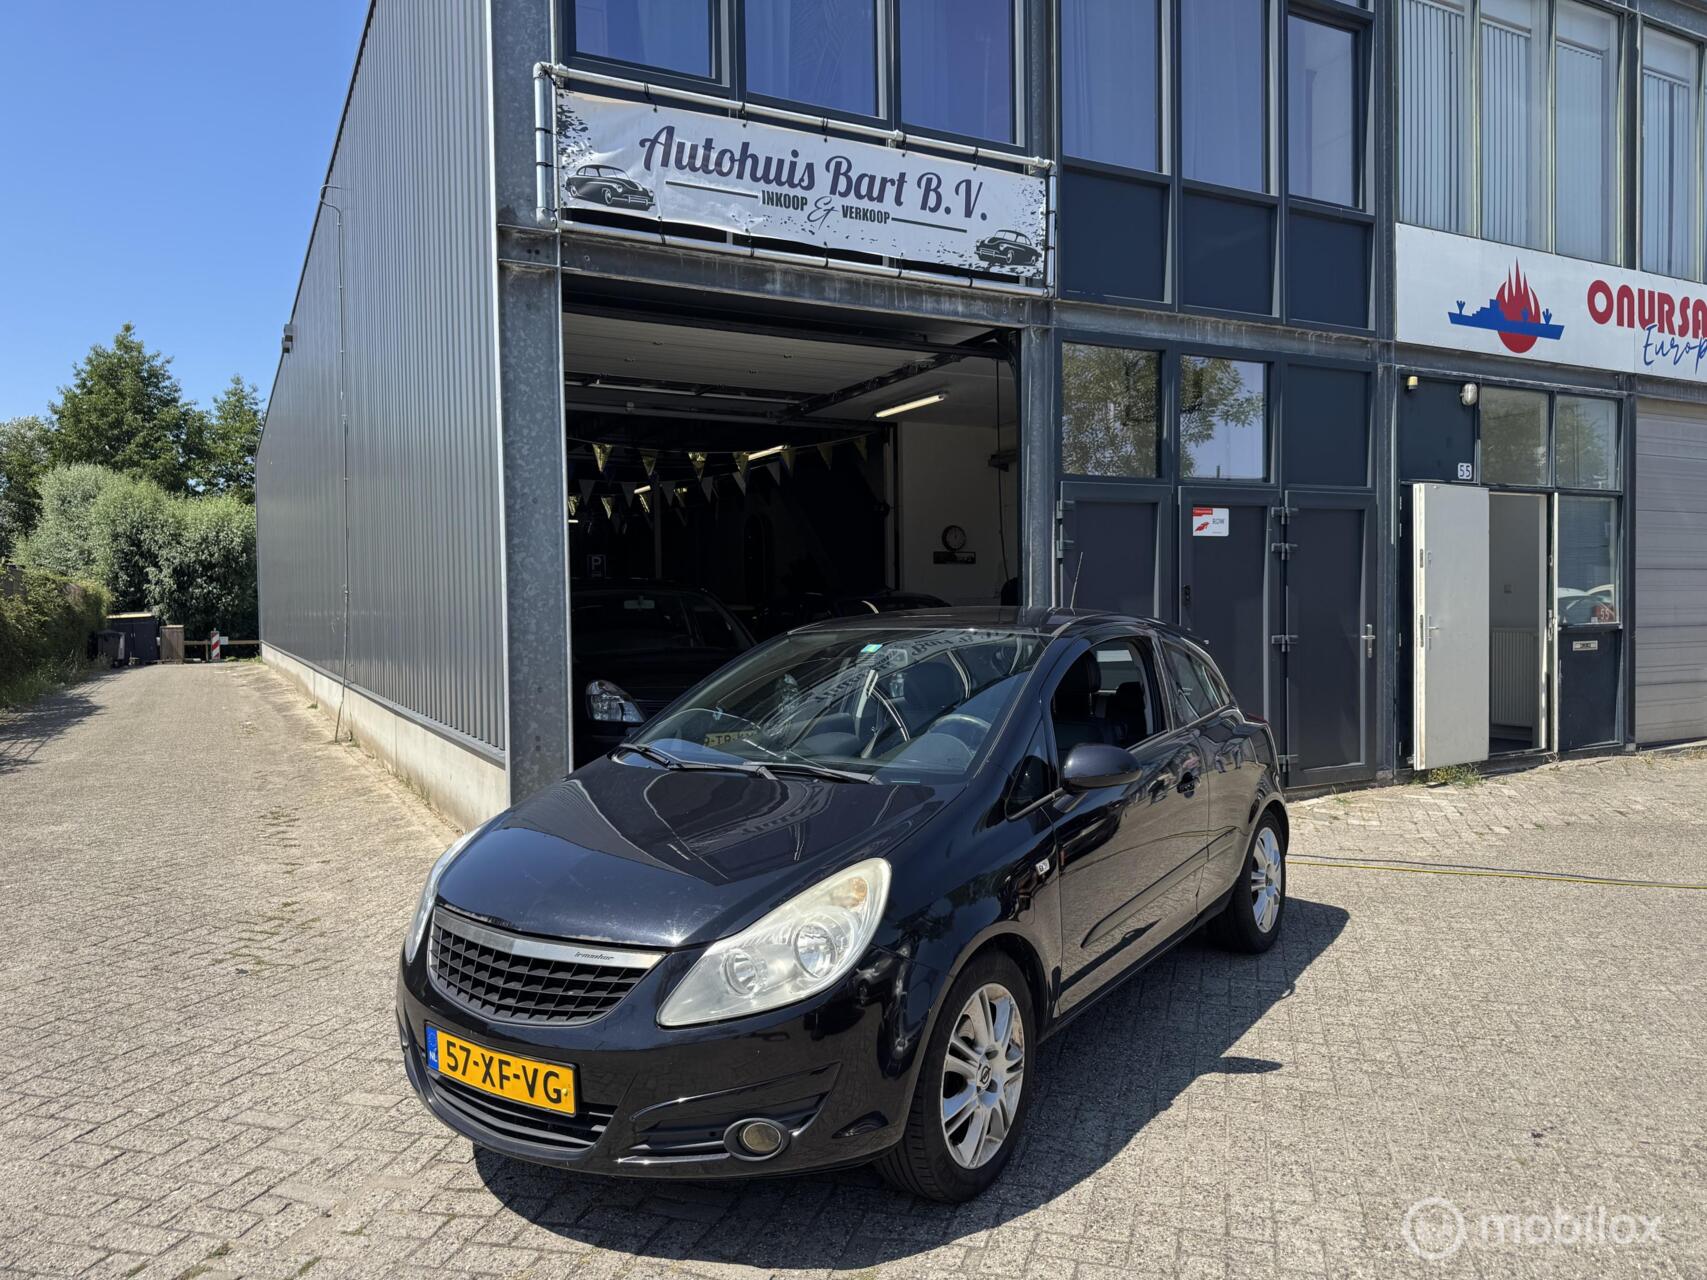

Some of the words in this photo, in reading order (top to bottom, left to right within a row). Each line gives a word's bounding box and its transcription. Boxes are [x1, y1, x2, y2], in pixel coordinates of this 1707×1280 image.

[639, 125, 815, 192] Autohuis
[825, 155, 908, 208] Bart
[917, 171, 988, 222] B.V.
[761, 190, 808, 211] INKOOP
[841, 204, 891, 225] VERKOOP
[1459, 464, 1471, 478] 55
[429, 1050, 438, 1063] NL
[446, 1039, 563, 1105] 57-XF-VG
